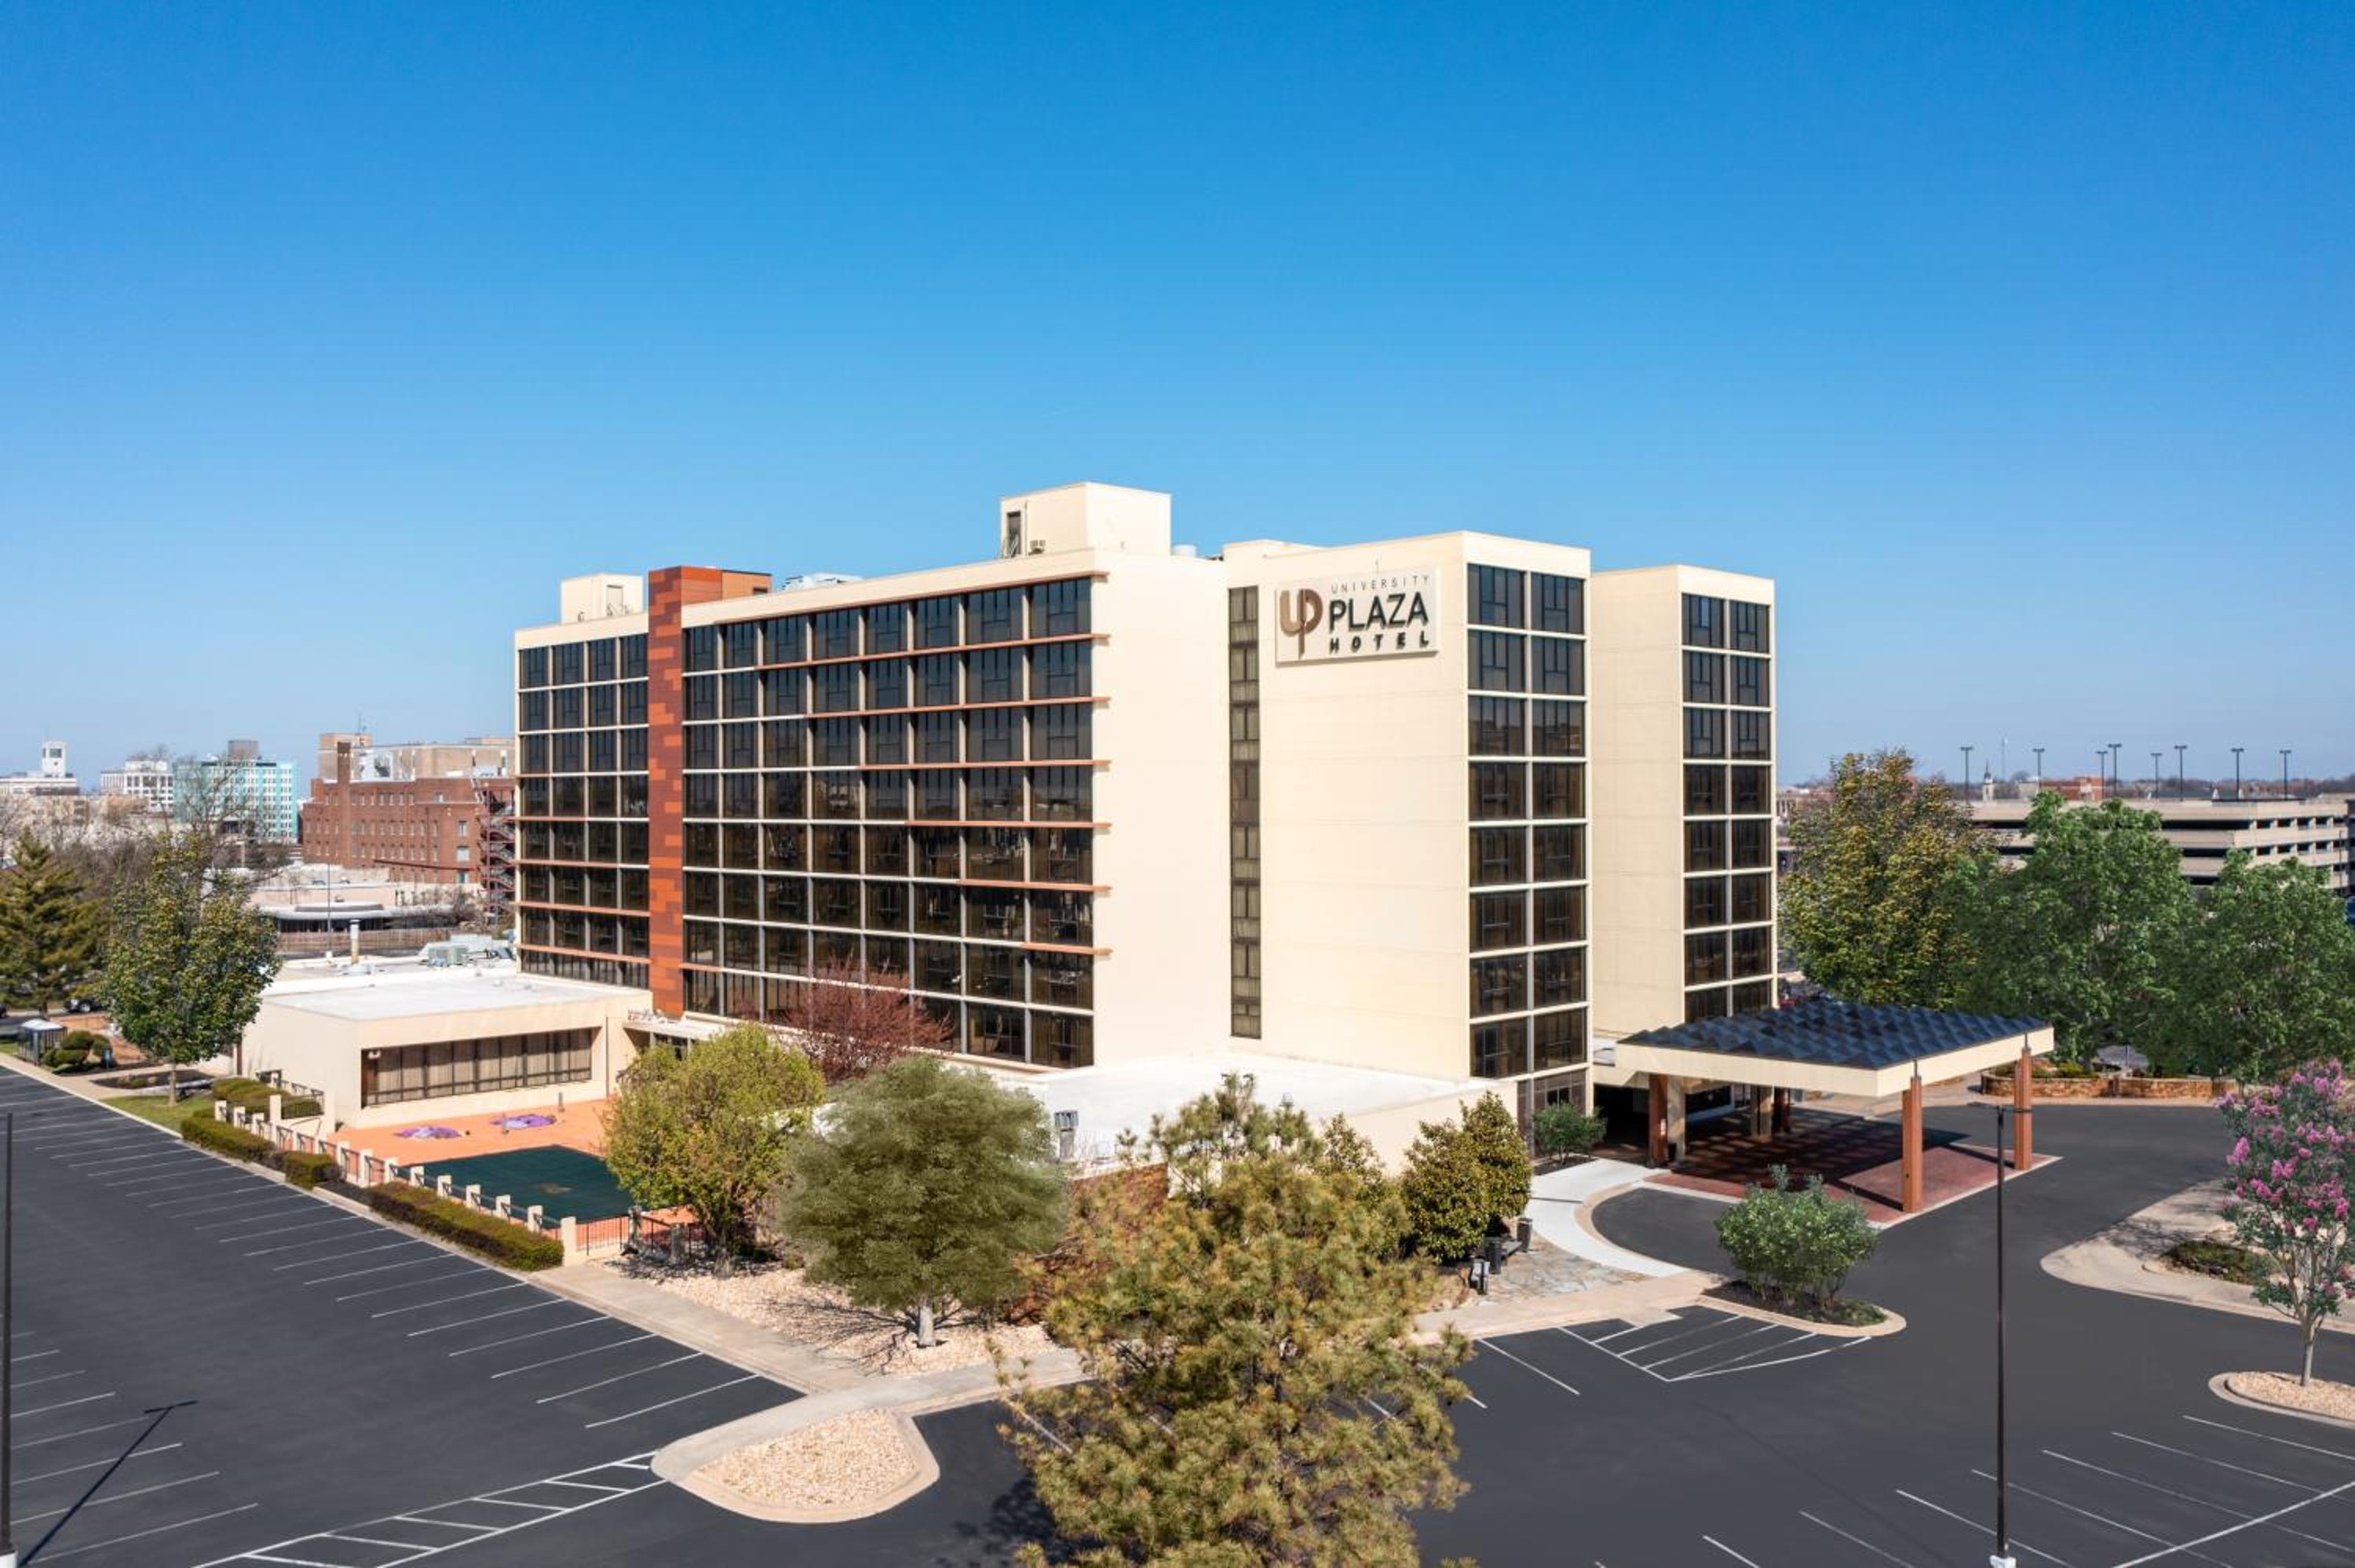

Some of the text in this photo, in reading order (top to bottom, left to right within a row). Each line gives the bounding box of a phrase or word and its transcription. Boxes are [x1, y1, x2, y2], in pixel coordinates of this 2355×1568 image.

[1331, 575, 1429, 594] UNIVERSITY
[1329, 592, 1429, 633] PLAZA
[1329, 630, 1429, 655] HOTEL
